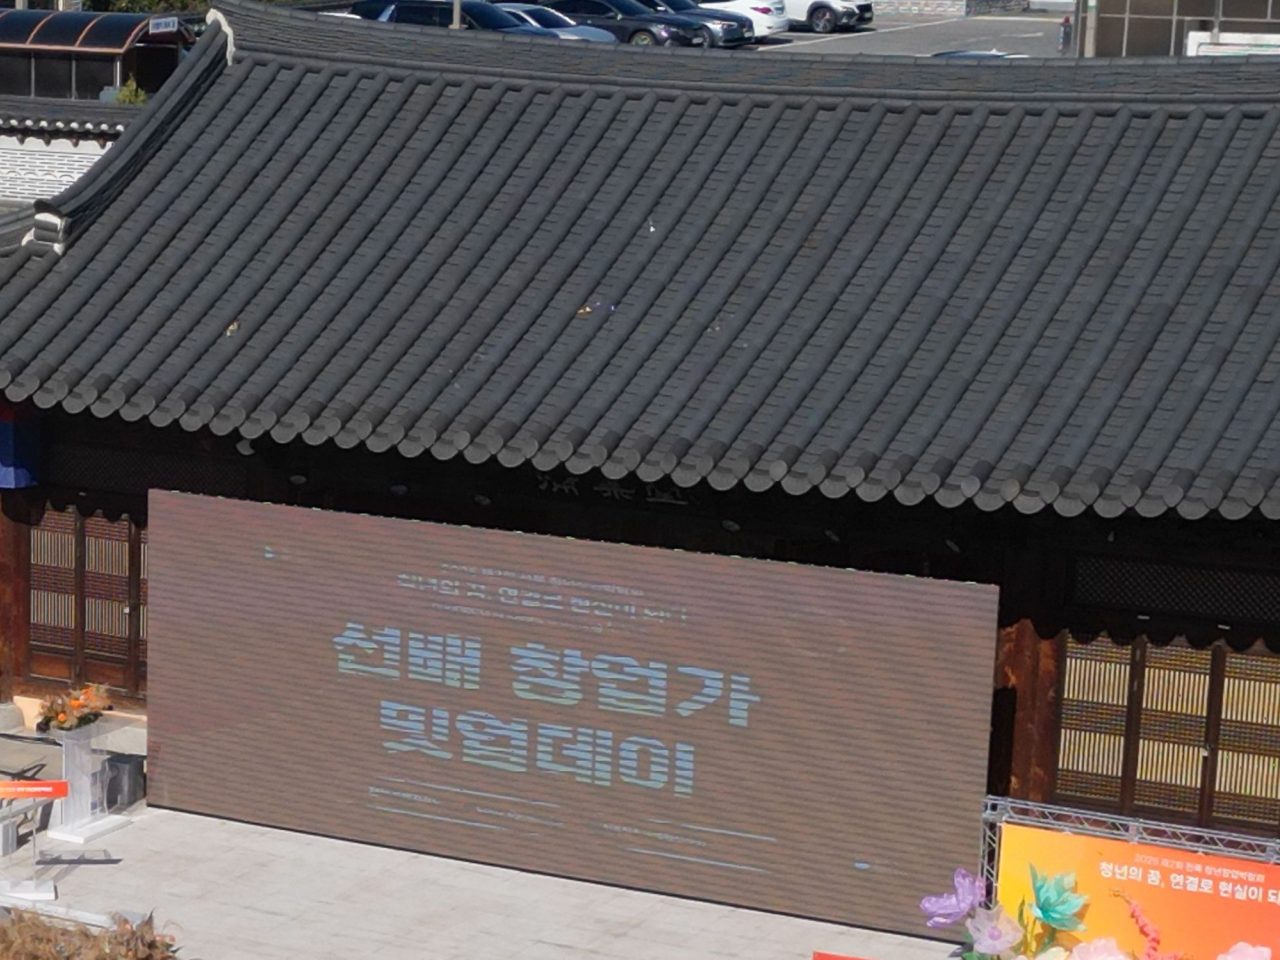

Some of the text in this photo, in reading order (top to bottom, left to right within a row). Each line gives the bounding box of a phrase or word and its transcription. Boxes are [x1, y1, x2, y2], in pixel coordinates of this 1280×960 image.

[332, 622, 762, 727] 선배 창업가
[379, 698, 697, 799] 밋업데이
[1099, 861, 1143, 882] 청년의
[1170, 873, 1214, 894] 연결로
[1219, 881, 1263, 903] 현실이
